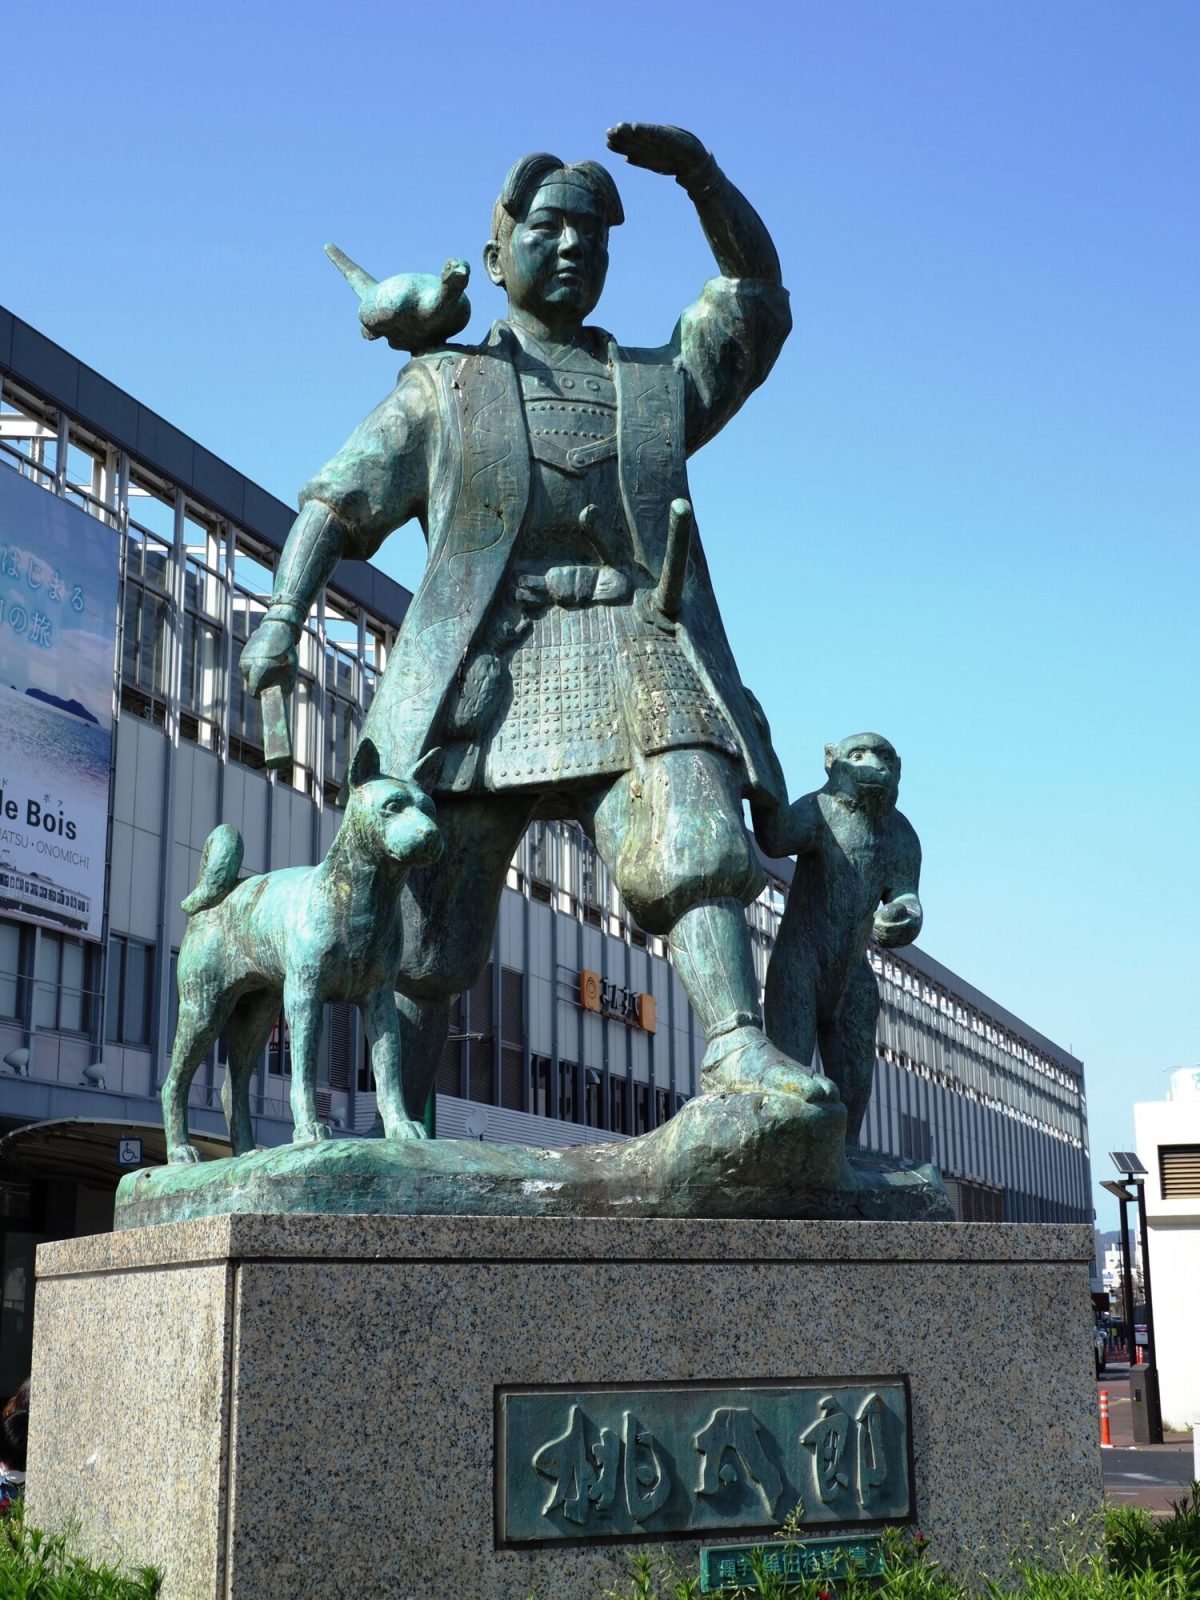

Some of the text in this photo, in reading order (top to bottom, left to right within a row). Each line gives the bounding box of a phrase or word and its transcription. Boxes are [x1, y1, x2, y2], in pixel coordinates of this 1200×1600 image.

[0, 599, 51, 647] の旅
[0, 788, 77, 840] e Bois
